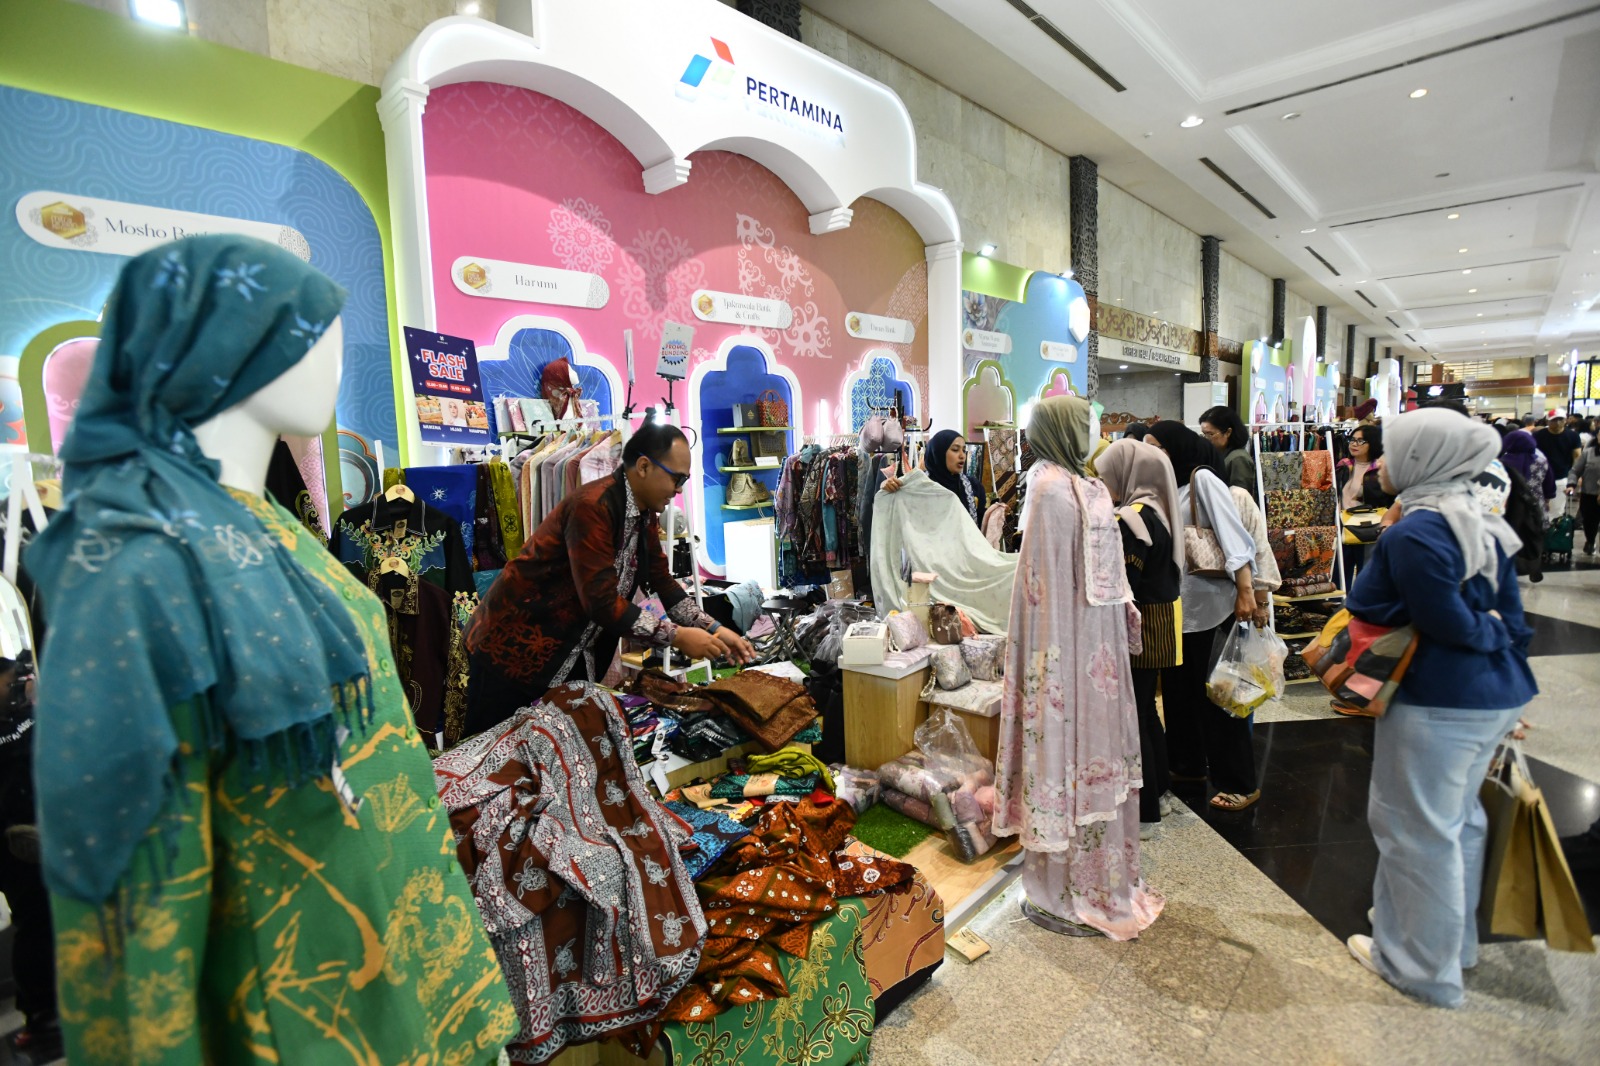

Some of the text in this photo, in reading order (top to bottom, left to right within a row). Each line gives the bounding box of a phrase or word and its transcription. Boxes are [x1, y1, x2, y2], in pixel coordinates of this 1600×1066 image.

[746, 76, 843, 133] PERTAMINA
[105, 217, 167, 239] Mosho
[514, 274, 558, 290] Harumi
[421, 348, 467, 370] FLASH
[429, 364, 465, 381] SALE
